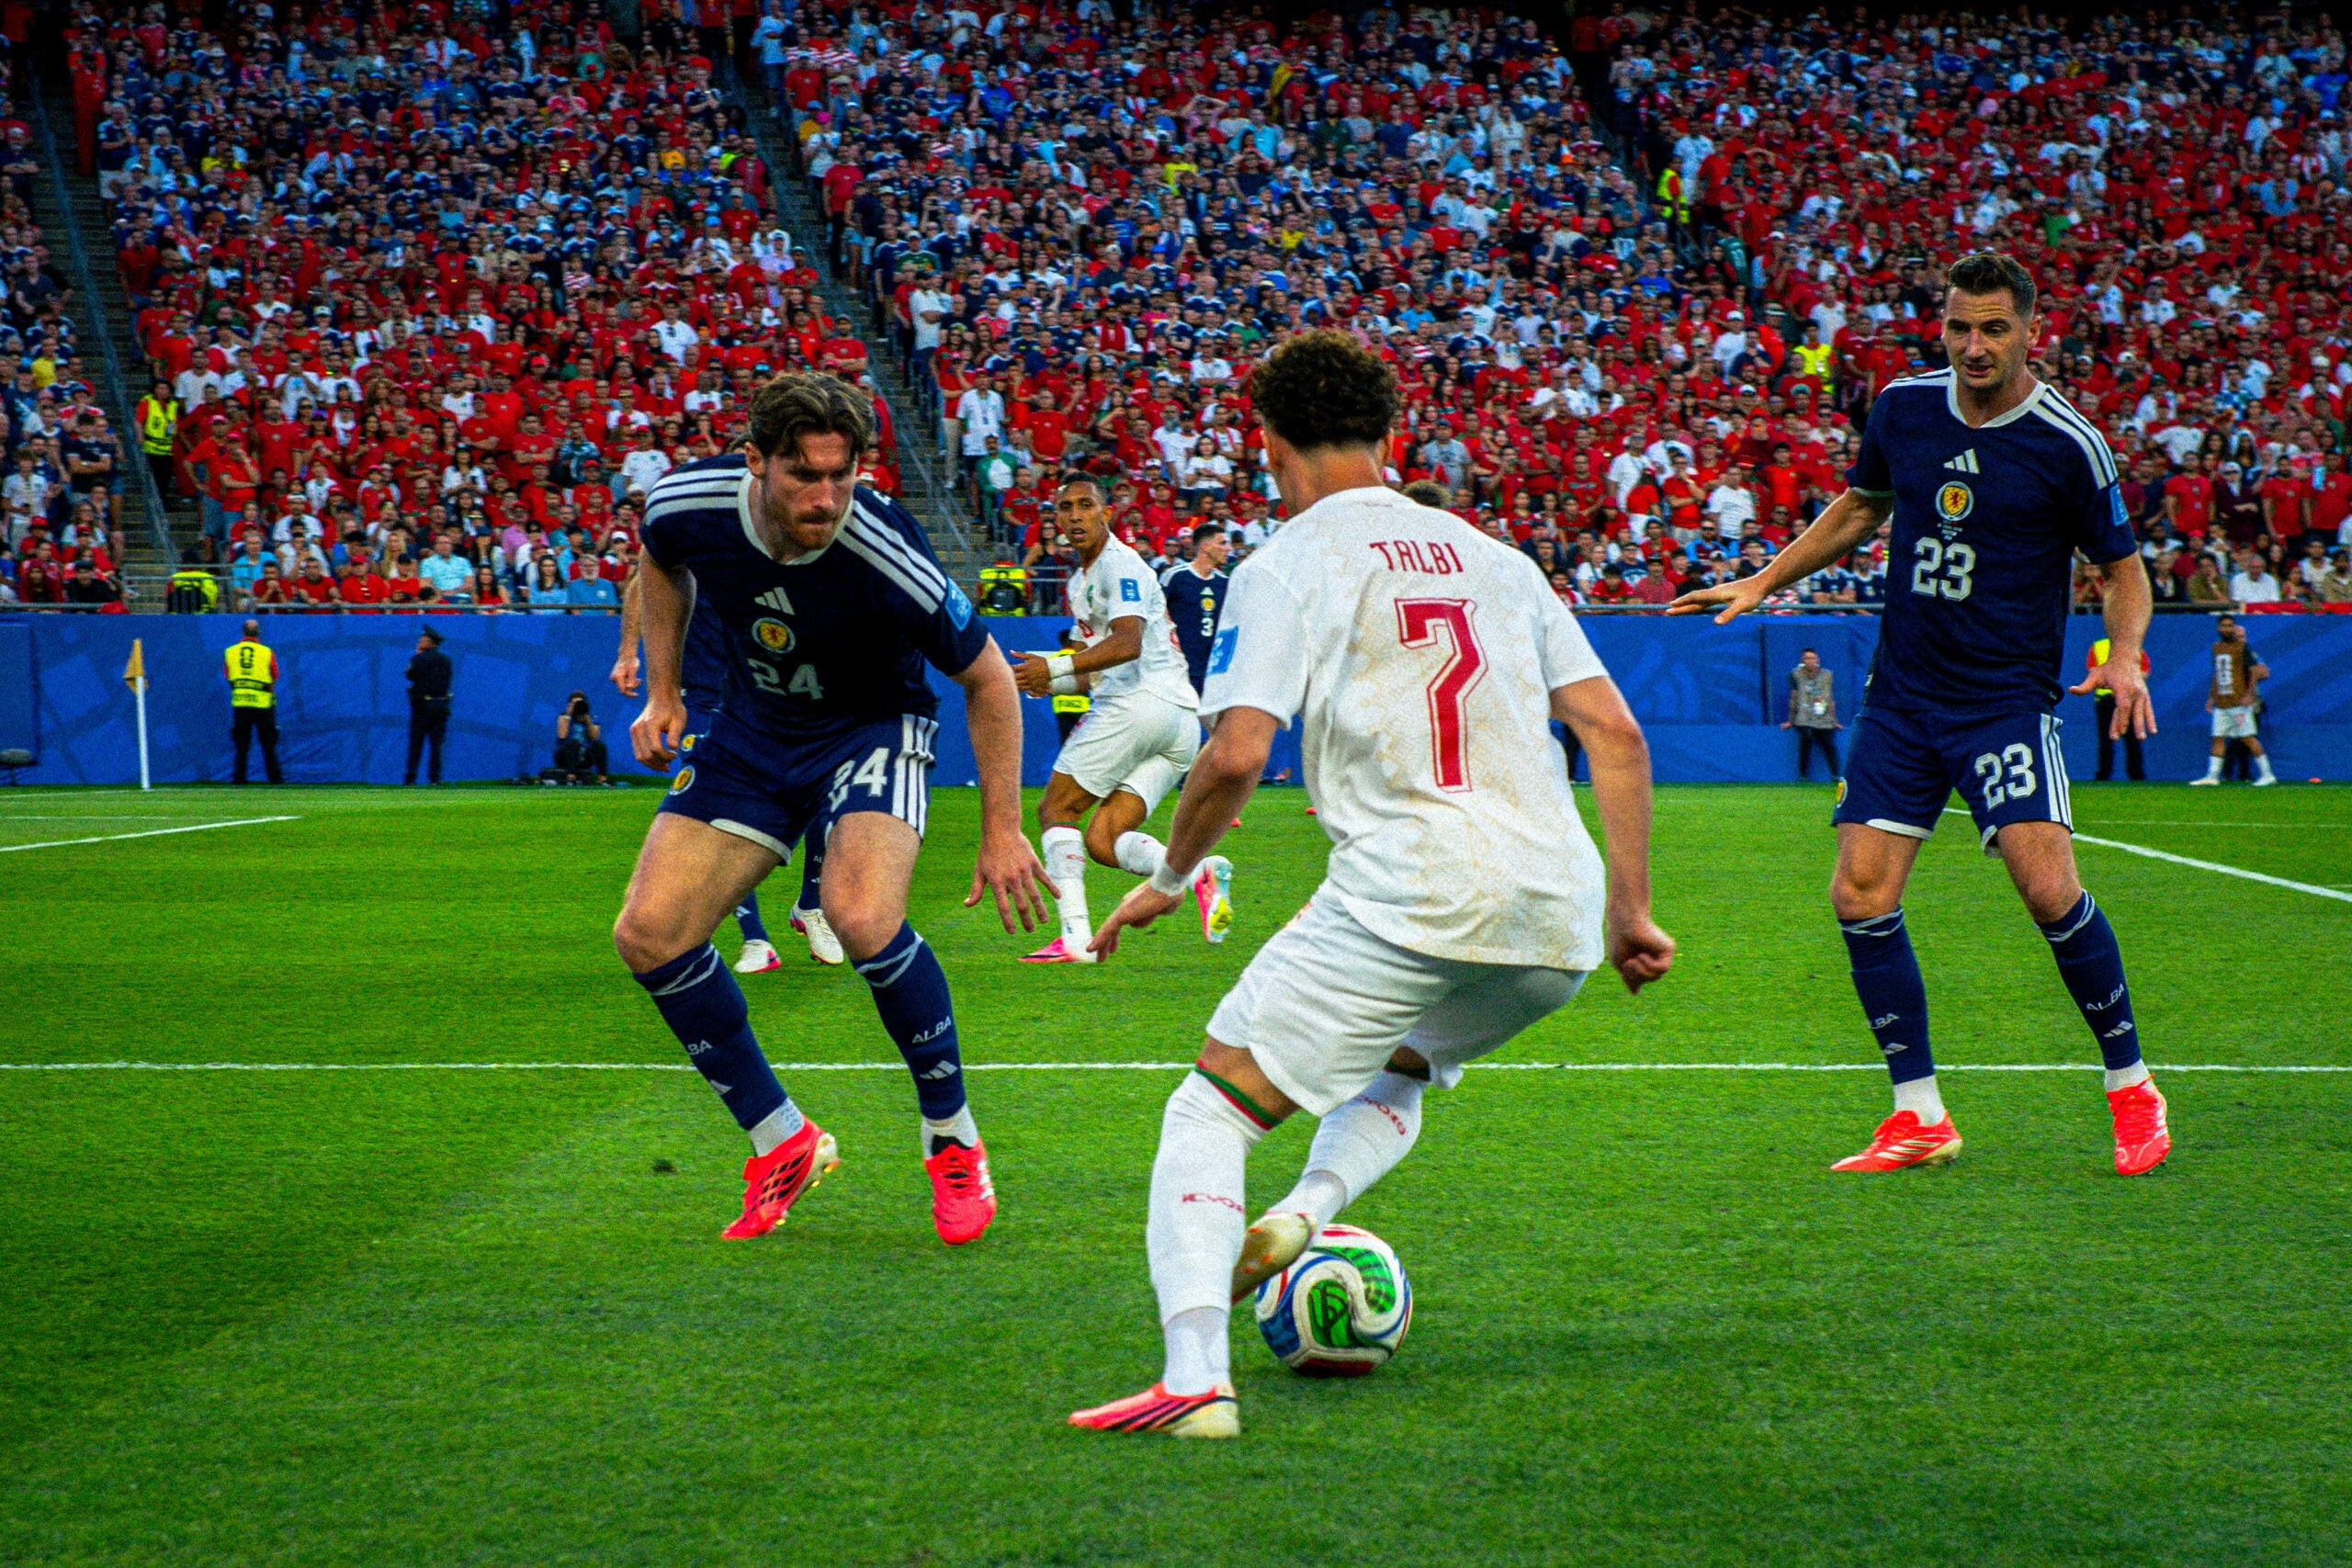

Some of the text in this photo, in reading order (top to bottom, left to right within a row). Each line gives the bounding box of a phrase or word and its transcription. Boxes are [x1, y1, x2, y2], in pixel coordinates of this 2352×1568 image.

[1369, 539, 1464, 575] TALBI
[1911, 536, 1976, 602] 23
[1201, 617, 1214, 637] 3
[747, 658, 824, 699] 24
[1395, 597, 1488, 793] 7
[827, 745, 889, 813] 24
[1974, 742, 2036, 812] 23
[2086, 983, 2124, 1010] ALBA
[687, 1039, 712, 1055] BA
[912, 1015, 952, 1043] ALBA
